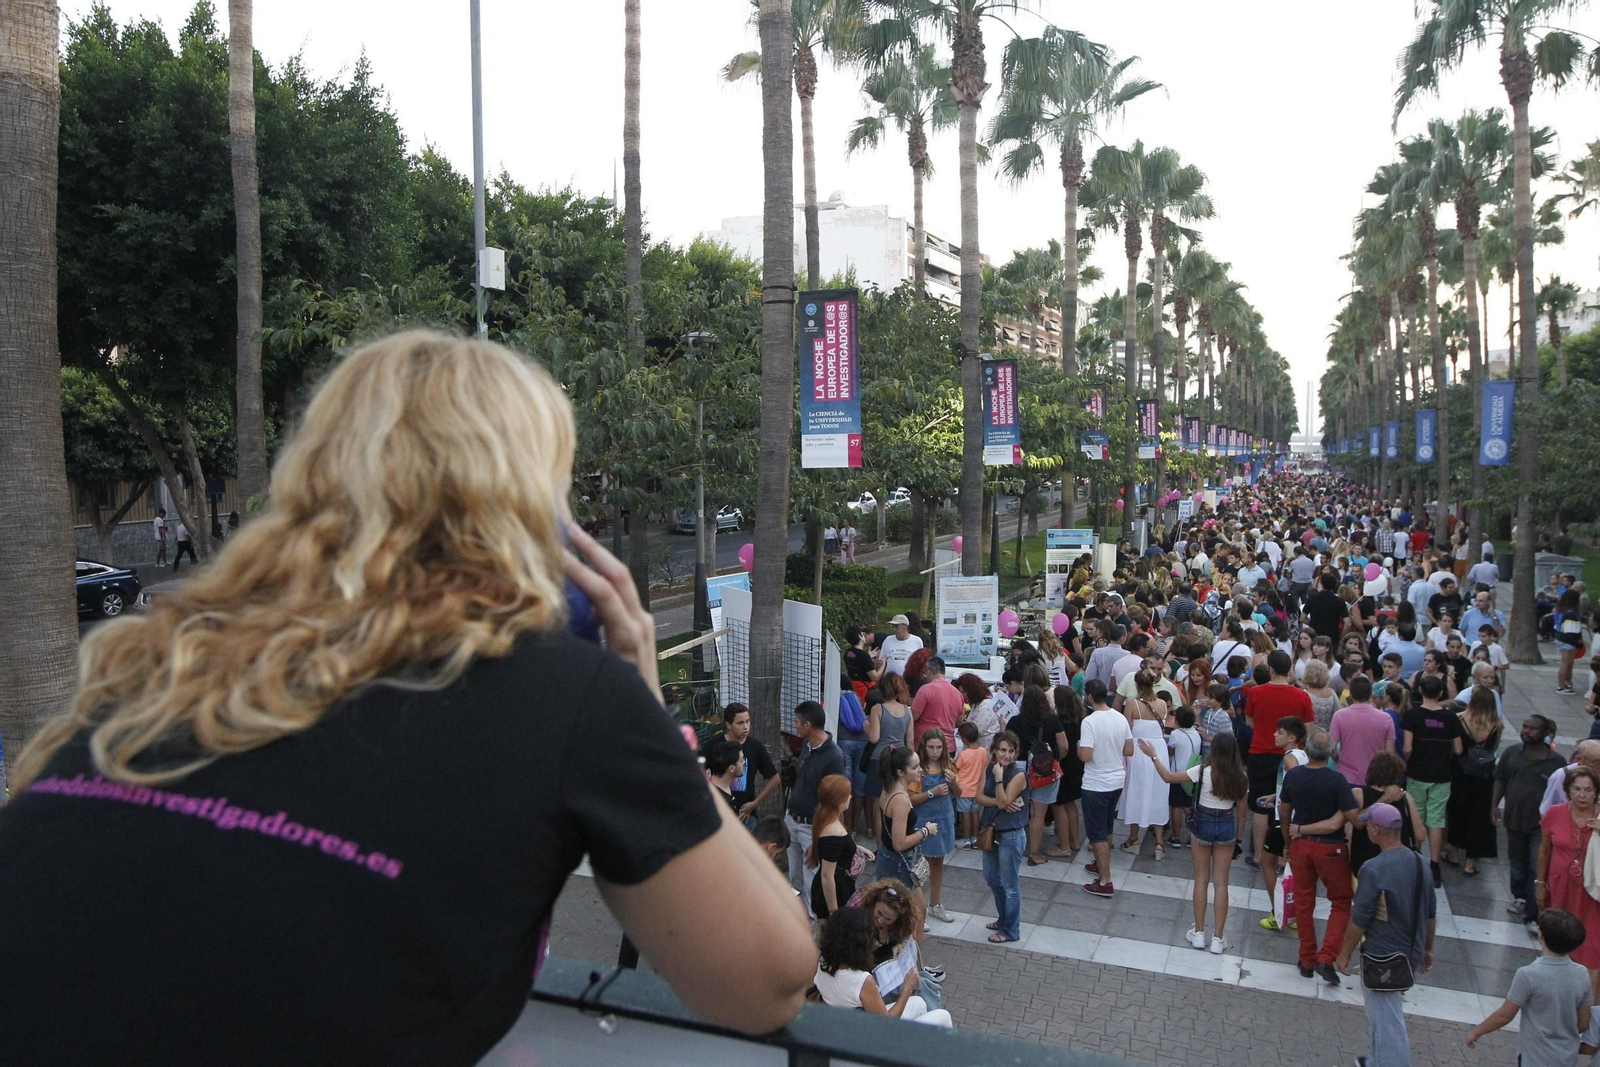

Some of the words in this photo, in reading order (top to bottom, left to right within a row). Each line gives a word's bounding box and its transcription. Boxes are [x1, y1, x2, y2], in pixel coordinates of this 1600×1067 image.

[826, 304, 836, 327] L@S
[826, 329, 836, 344] DE
[814, 341, 825, 379] NOCHE
[838, 303, 849, 398] INVESTIGADOR@S
[827, 347, 837, 398] EUROPEA
[815, 384, 825, 399] LA
[998, 382, 1005, 392] DE
[1006, 367, 1014, 424] INVESTIGADOR@S
[992, 415, 999, 425] LA
[850, 439, 860, 447] 57
